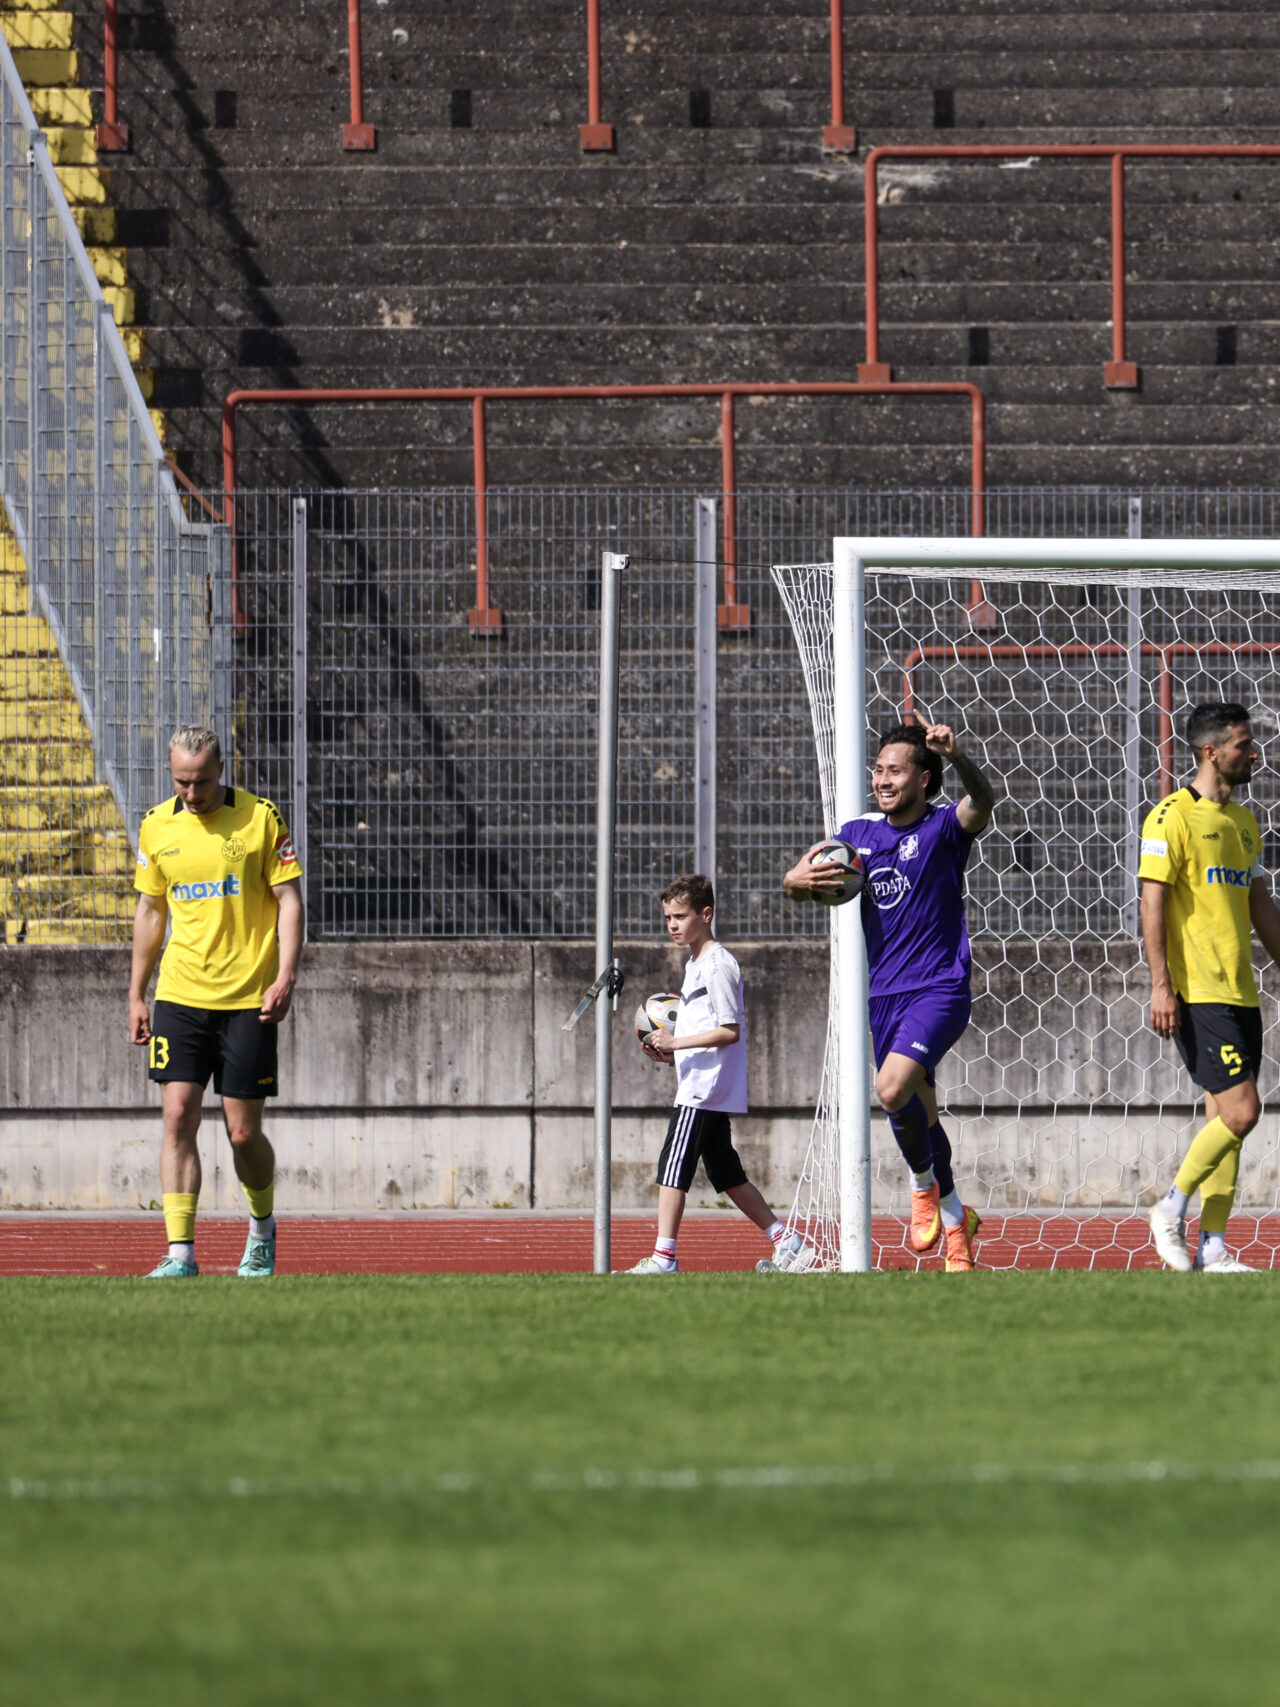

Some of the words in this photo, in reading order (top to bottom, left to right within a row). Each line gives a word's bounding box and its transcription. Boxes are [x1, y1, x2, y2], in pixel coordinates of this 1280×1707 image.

[172, 874, 240, 900] maxit
[150, 1035, 170, 1069] 13
[1220, 1045, 1242, 1076] 5
